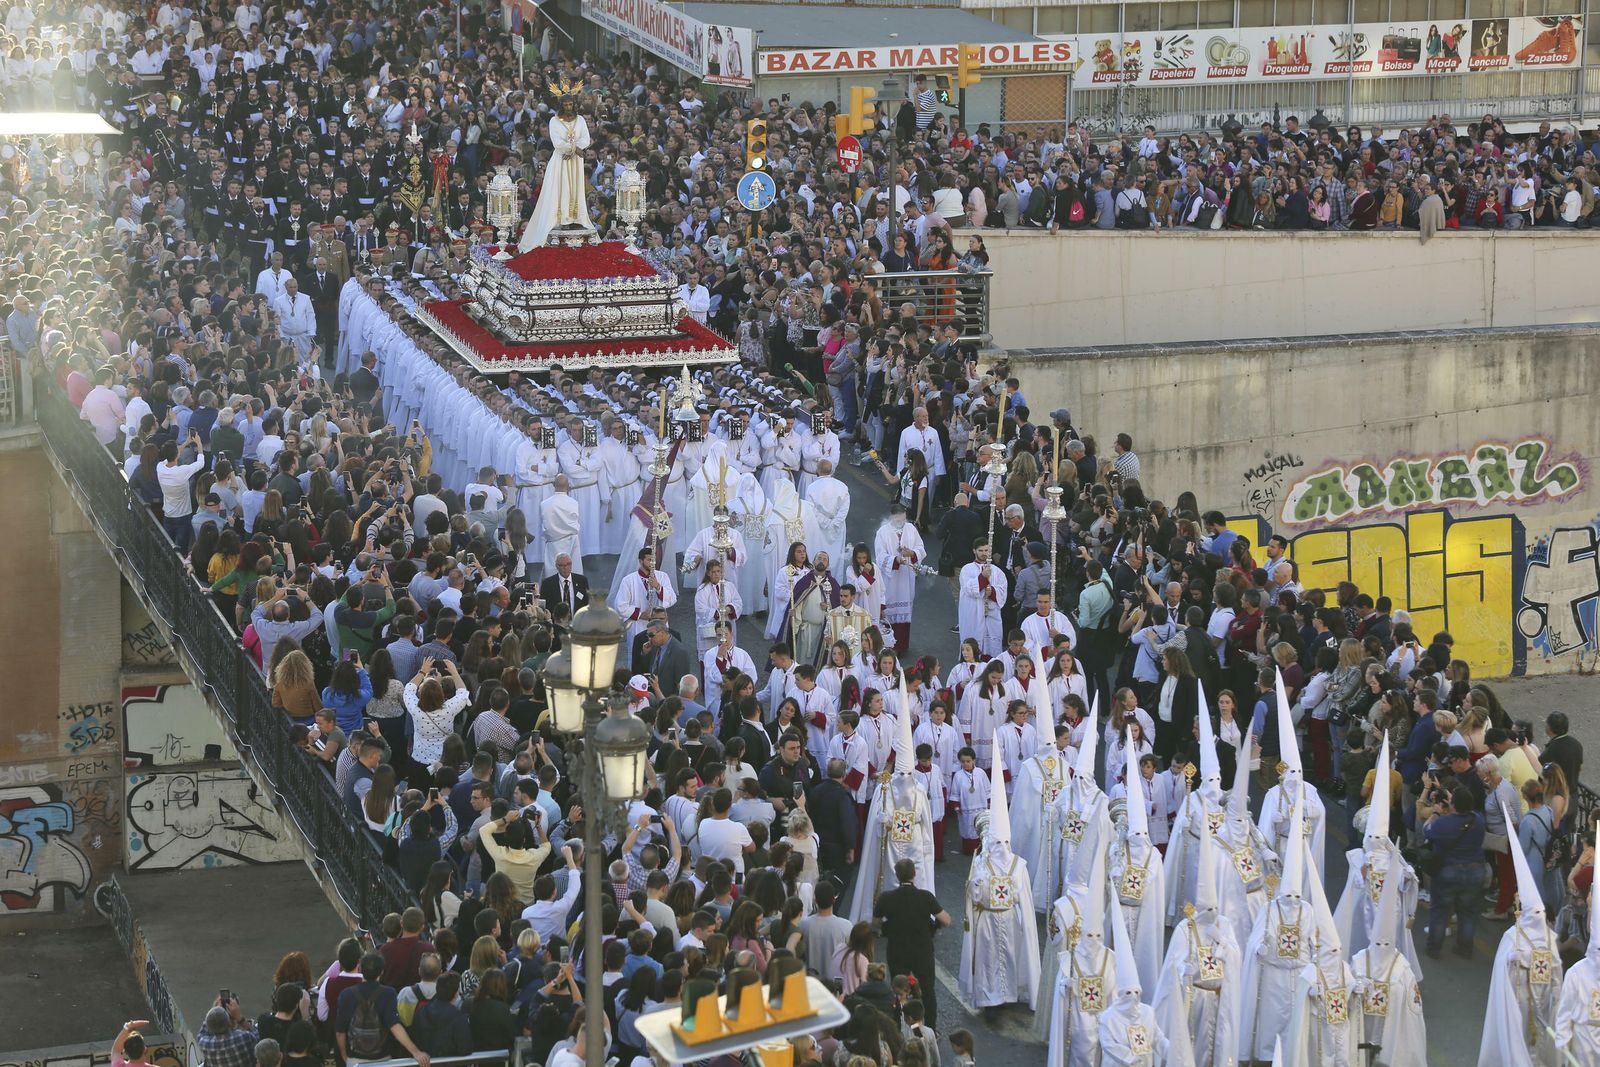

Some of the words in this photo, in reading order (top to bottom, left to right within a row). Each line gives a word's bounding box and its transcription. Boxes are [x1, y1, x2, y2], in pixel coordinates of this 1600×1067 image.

[767, 50, 877, 72] BAZAR
[1428, 59, 1457, 68] Moda
[1527, 53, 1568, 64] Zapatos
[1384, 61, 1412, 70] Bolsos
[1094, 71, 1138, 83] Juguees
[1209, 66, 1247, 77] Menajes
